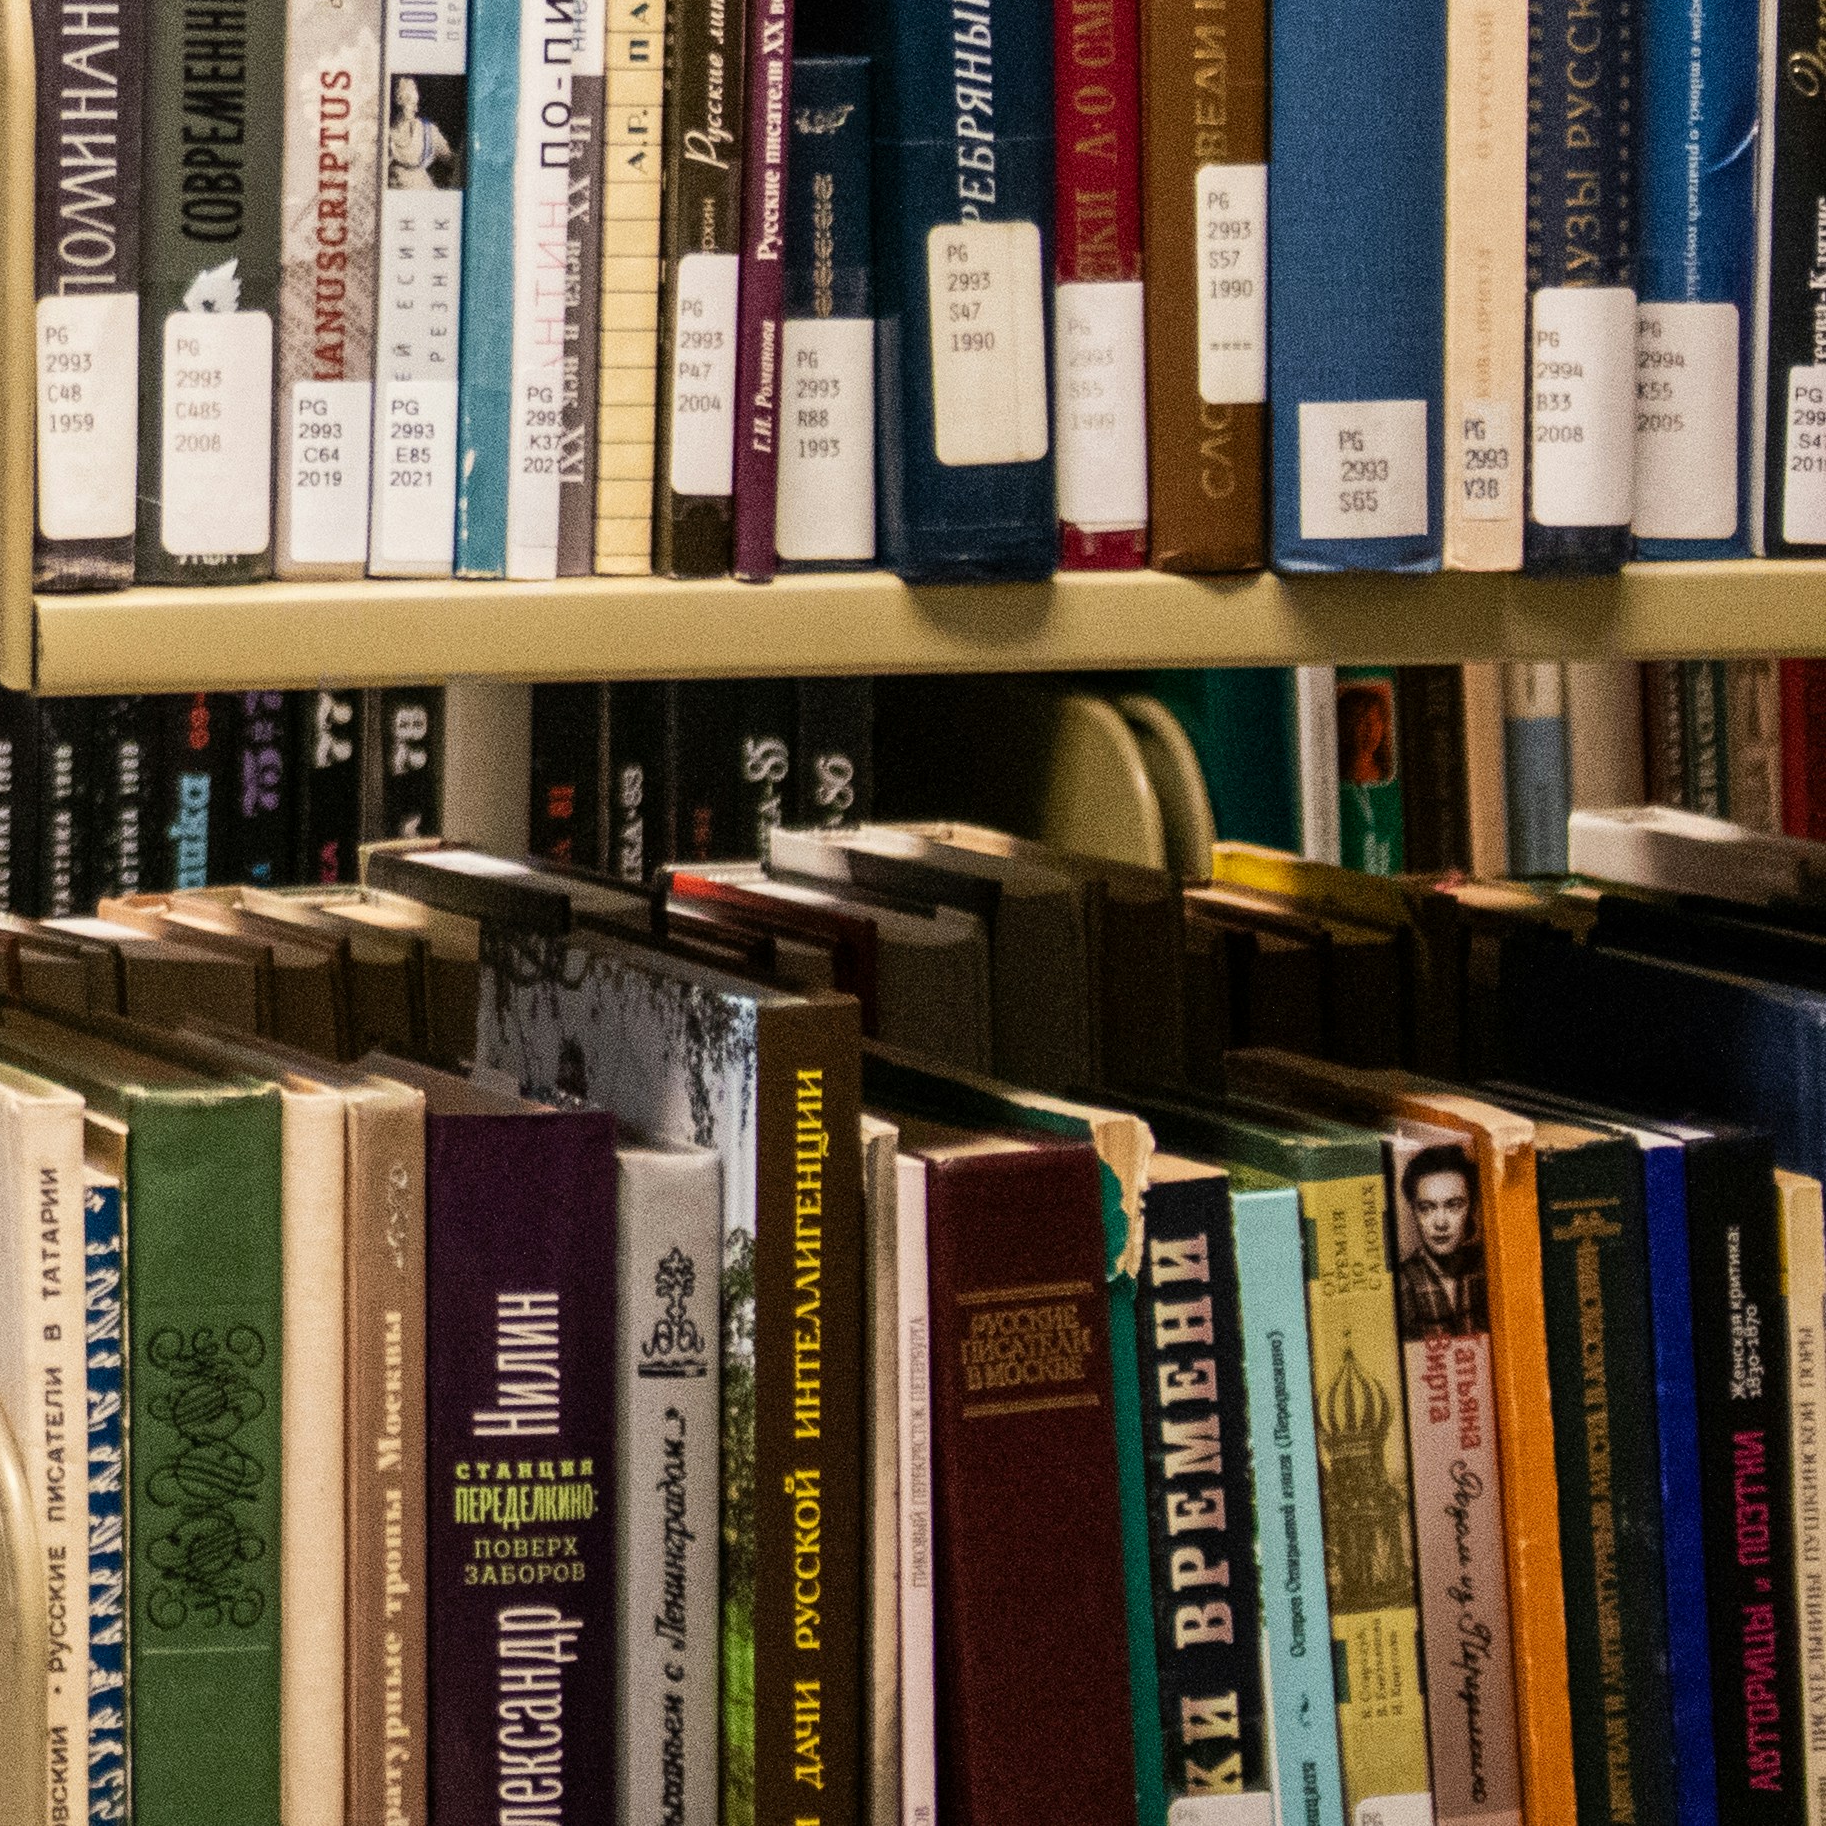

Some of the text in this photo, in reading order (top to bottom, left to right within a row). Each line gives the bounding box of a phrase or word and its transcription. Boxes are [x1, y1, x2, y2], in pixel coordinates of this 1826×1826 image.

[396, 216, 417, 311] ЕСИН
[429, 217, 450, 363] РЕЗНИК
[299, 400, 328, 416] PG
[391, 400, 419, 416] PG
[298, 424, 342, 440] 2993
[391, 424, 435, 440] 2993
[1338, 430, 1364, 453] PG
[298, 472, 342, 487] 2019
[390, 472, 433, 487] 2021
[1340, 459, 1389, 482] 2993
[472, 1292, 560, 1436] Нилин
[41, 1168, 74, 1674] РУССКИЕ ПИСАТЕЛИ В ТАТАРИИ
[783, 1069, 830, 1790] ДАЧИ РУССКОЙ ИНТЕЛЛИГЕНЦИИ
[455, 1458, 594, 1481] СТАНЦИЯ
[1149, 1232, 1245, 1797] КИ ВРЕМЕНИ
[474, 1536, 579, 1560] ПОВЕРХ
[464, 1562, 586, 1587] ЗАБОРОВ
[498, 1605, 584, 1826] лександр
